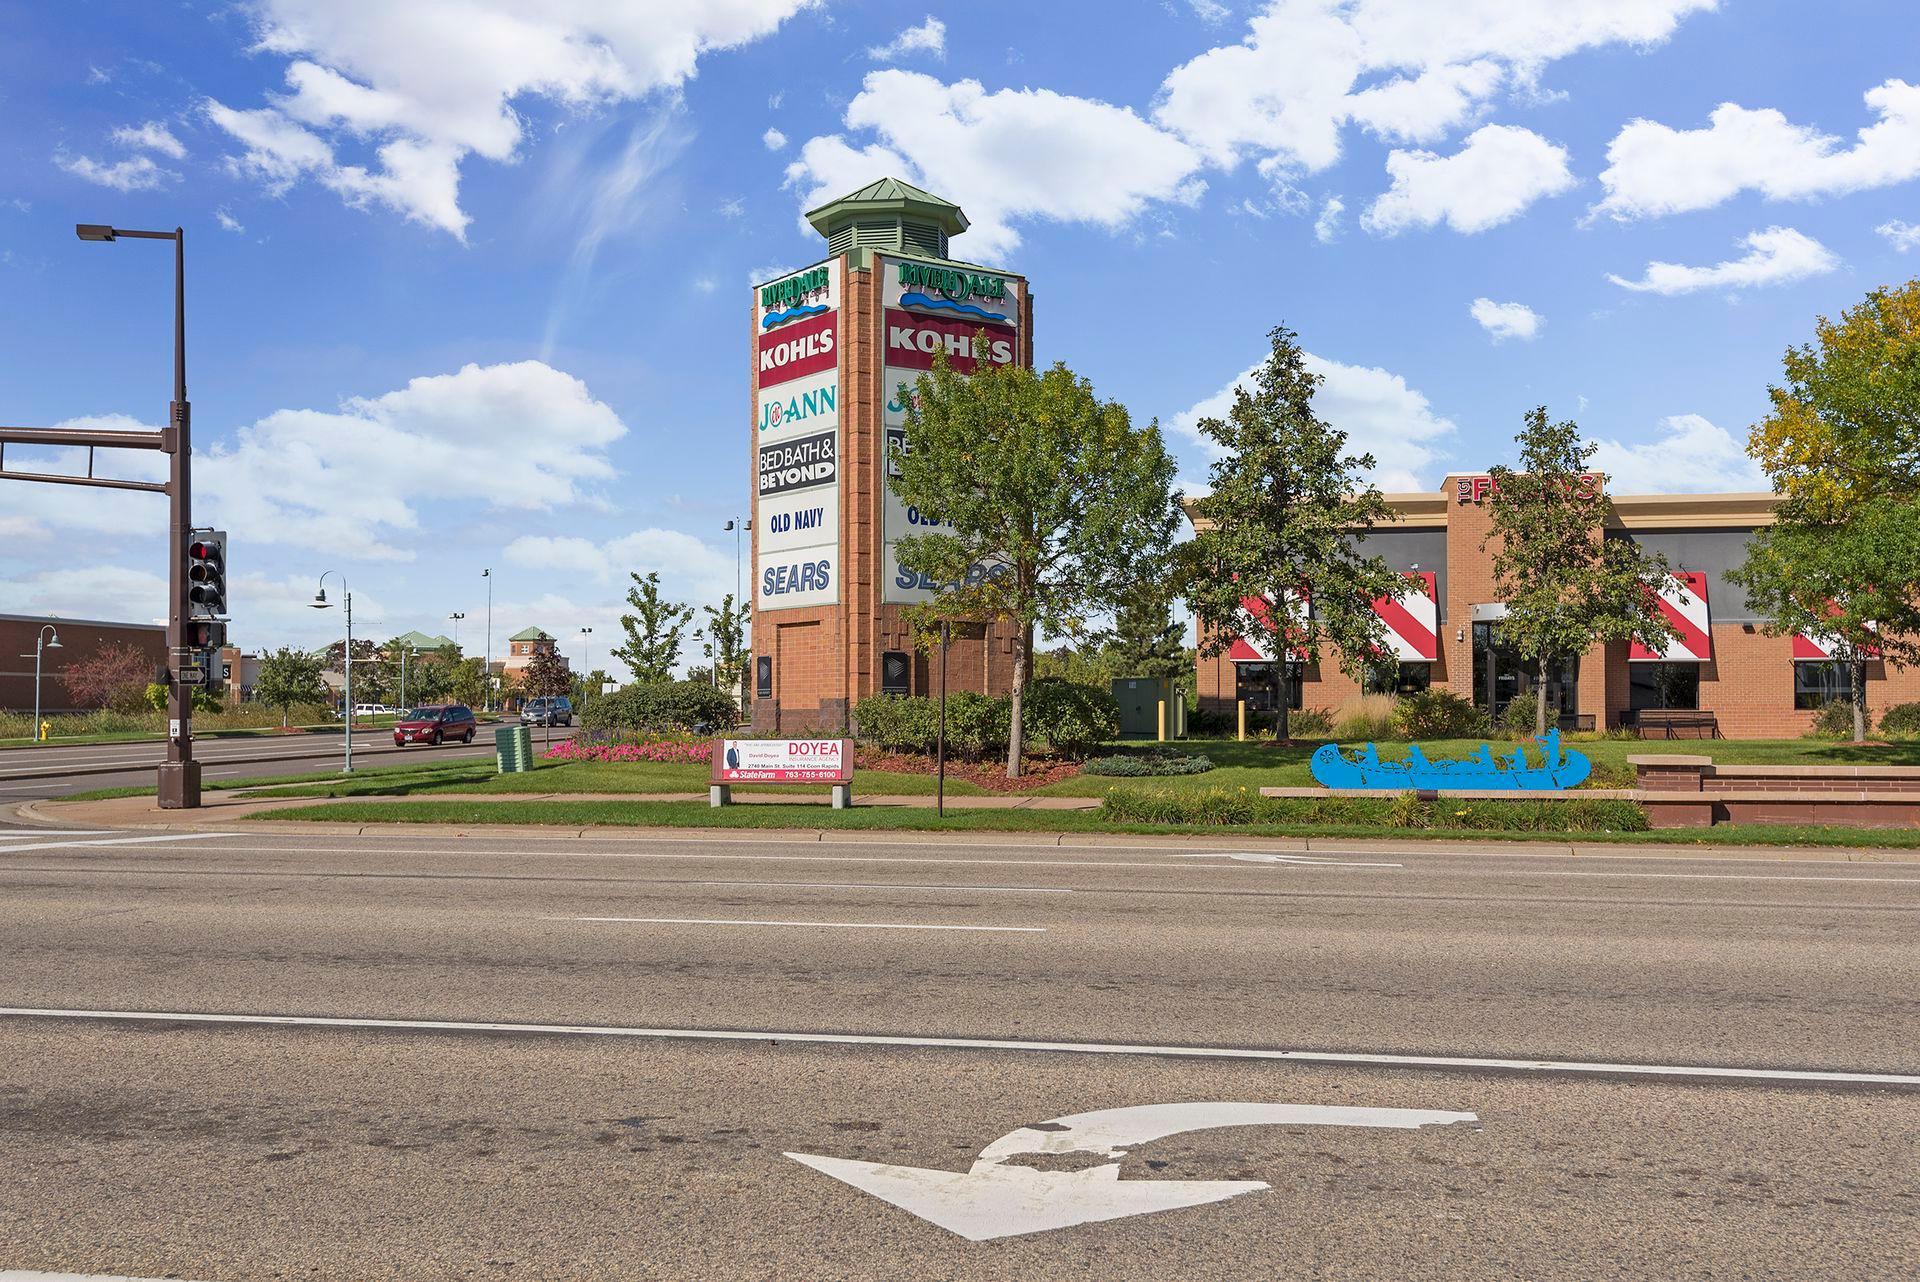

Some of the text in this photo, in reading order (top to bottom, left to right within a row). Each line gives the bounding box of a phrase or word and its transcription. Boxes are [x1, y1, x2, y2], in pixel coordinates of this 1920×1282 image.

[761, 266, 829, 308] RIVERDALE
[899, 263, 1006, 302] RIVERDALE
[760, 328, 834, 372] KOHL'S
[890, 326, 1012, 364] KOHS
[760, 438, 834, 471] BED BATH &
[760, 461, 835, 490] BEYOND
[770, 508, 824, 534] OLD NAVY
[762, 560, 831, 596] SEARS
[789, 742, 839, 755] DOYEA
